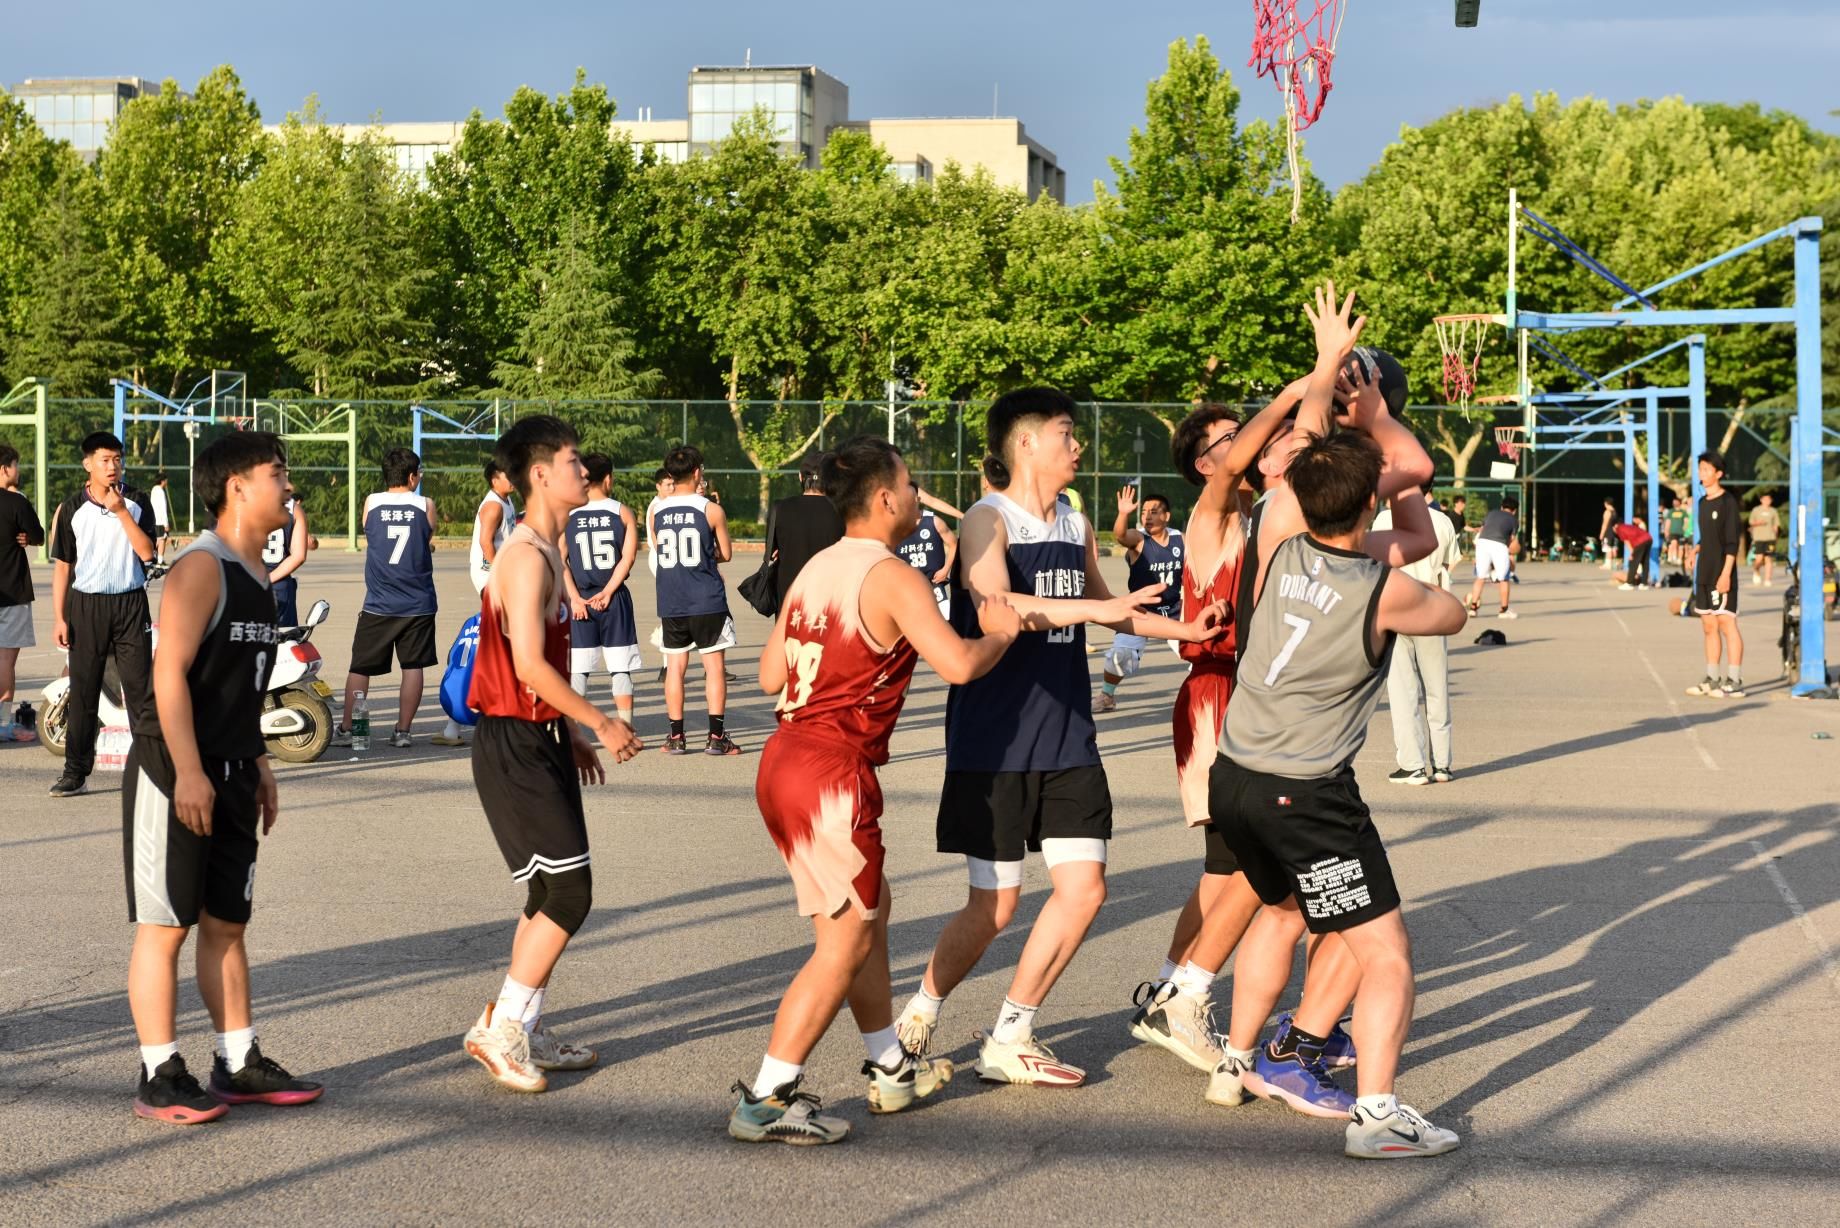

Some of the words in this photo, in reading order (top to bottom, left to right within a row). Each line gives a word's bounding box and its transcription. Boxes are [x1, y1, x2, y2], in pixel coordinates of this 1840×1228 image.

[576, 515, 611, 528] 王伟豪
[387, 525, 411, 565] 7
[575, 530, 616, 571] 15
[657, 527, 701, 569] 30
[1159, 571, 1174, 586] 14
[1279, 573, 1343, 615] DURANT
[1263, 612, 1312, 687] 7
